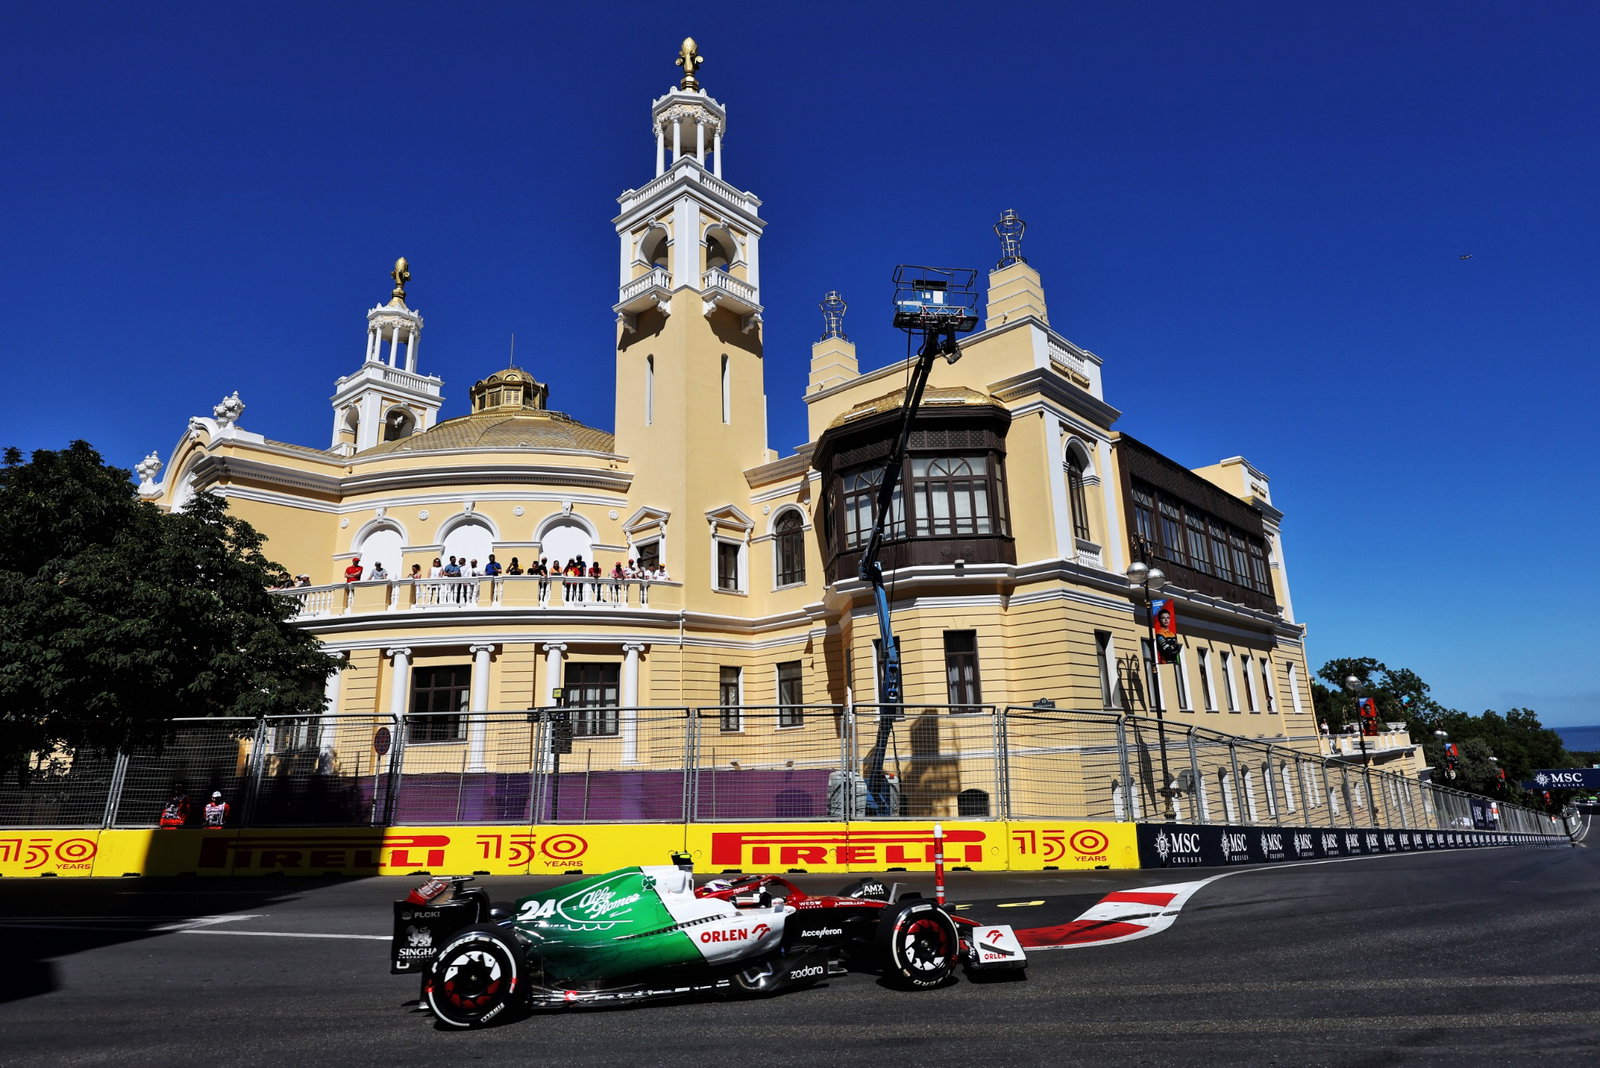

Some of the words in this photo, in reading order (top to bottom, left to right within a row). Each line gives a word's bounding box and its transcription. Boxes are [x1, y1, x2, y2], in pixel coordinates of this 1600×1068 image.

[1550, 772, 1583, 783] MSC
[198, 835, 451, 868] PIRELLI
[476, 833, 588, 867] 150
[711, 830, 987, 865] PIRELLI
[1012, 829, 1109, 862] 150
[1170, 833, 1200, 853] MSC
[1229, 833, 1248, 852] MSC
[1266, 833, 1283, 851] MSC
[0, 838, 98, 870] 150
[543, 860, 584, 868] YEARS
[579, 886, 616, 908] Alfa
[863, 883, 884, 893] AMX
[516, 898, 557, 920] 24
[584, 892, 640, 919] Romeo
[700, 928, 748, 943] ORLEN
[399, 947, 437, 956] SINGHA
